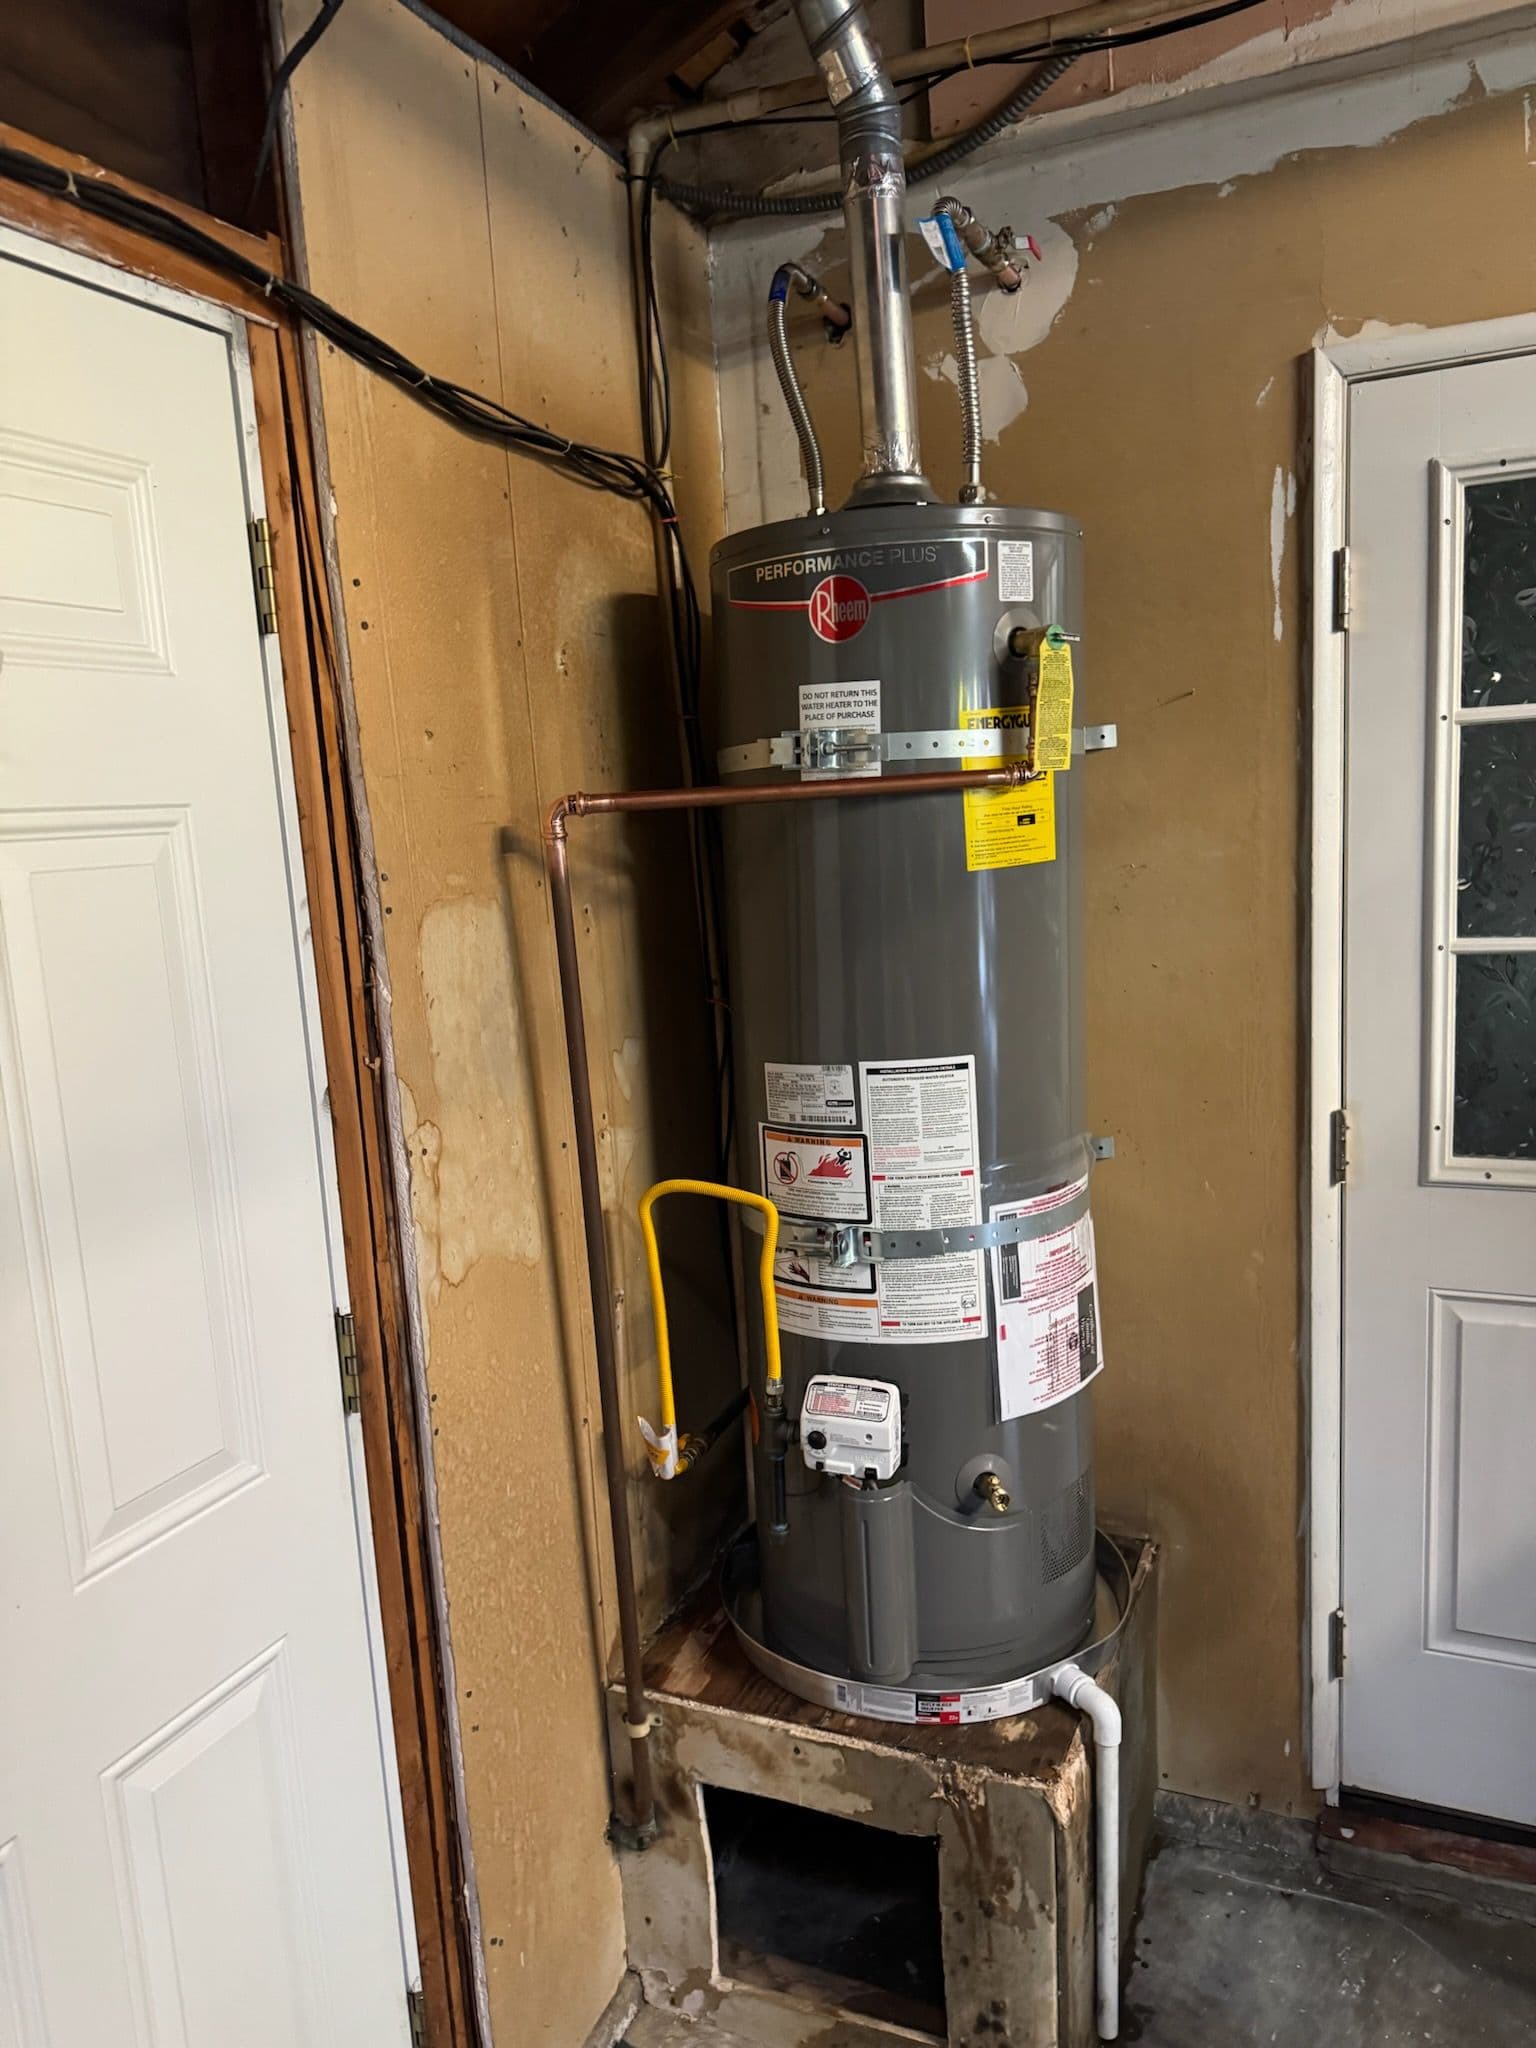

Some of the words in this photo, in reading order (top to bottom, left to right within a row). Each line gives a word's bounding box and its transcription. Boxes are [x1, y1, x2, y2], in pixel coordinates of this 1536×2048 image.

[756, 551, 885, 582] PERFORMANCE
[891, 546, 936, 564] PLUS
[816, 579, 867, 630] Rheem
[802, 692, 813, 700] DO
[814, 691, 829, 700] NOT
[830, 690, 859, 699] RETURN
[861, 689, 878, 697] THIS
[801, 703, 825, 711] WATER
[826, 701, 852, 710] HEATER
[853, 700, 864, 708] TO
[865, 699, 878, 707] THE
[804, 712, 825, 721] PLACE
[826, 712, 836, 720] OF
[837, 710, 876, 720] PURCHASE
[794, 1136, 832, 1146] WARNING
[806, 1295, 839, 1305] WARNING
